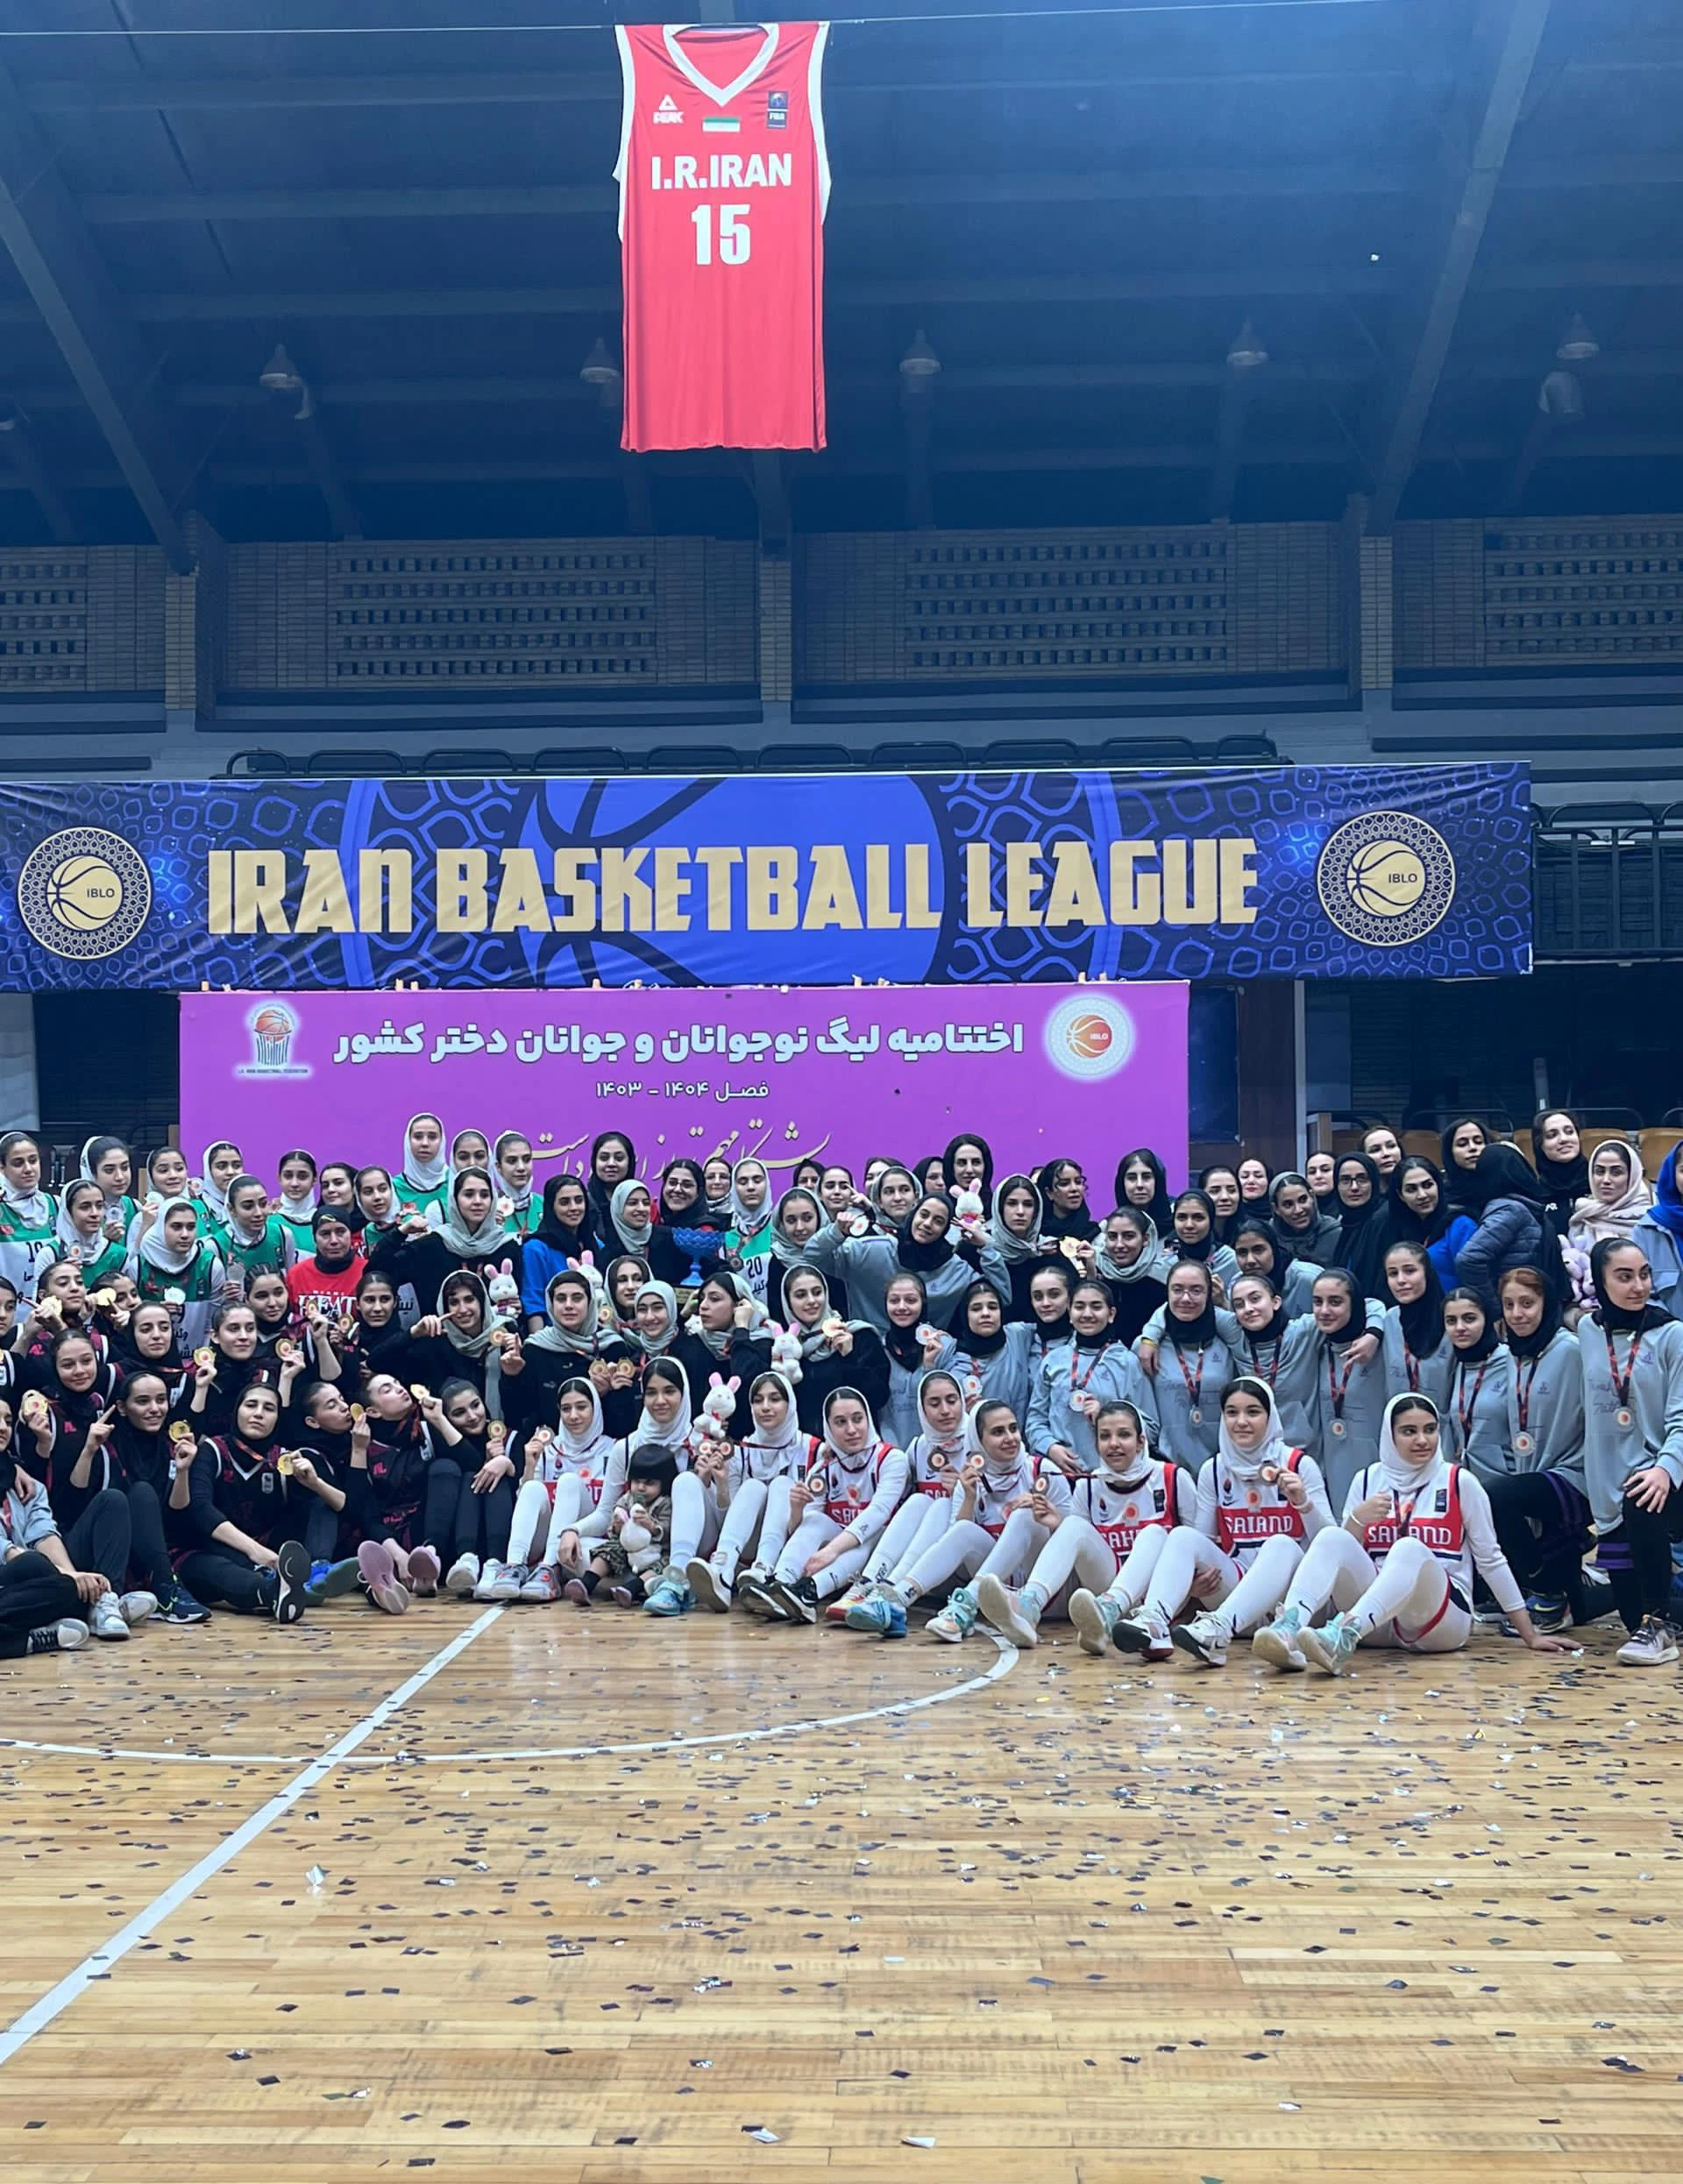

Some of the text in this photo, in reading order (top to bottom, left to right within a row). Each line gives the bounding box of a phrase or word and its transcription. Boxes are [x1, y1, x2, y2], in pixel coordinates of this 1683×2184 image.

[651, 153, 792, 189] I.R.IRAN
[691, 203, 751, 265] 15
[209, 837, 1259, 934] IRAN BASKETBALL LEAGUE
[1388, 873, 1417, 883] IBLO
[87, 888, 116, 898] IBLO
[332, 1016, 1024, 1063] اختتامیه لیگ نوجوانان و جوانان دختر کشور
[714, 1081, 770, 1103] فصل
[746, 1256, 763, 1279] 20
